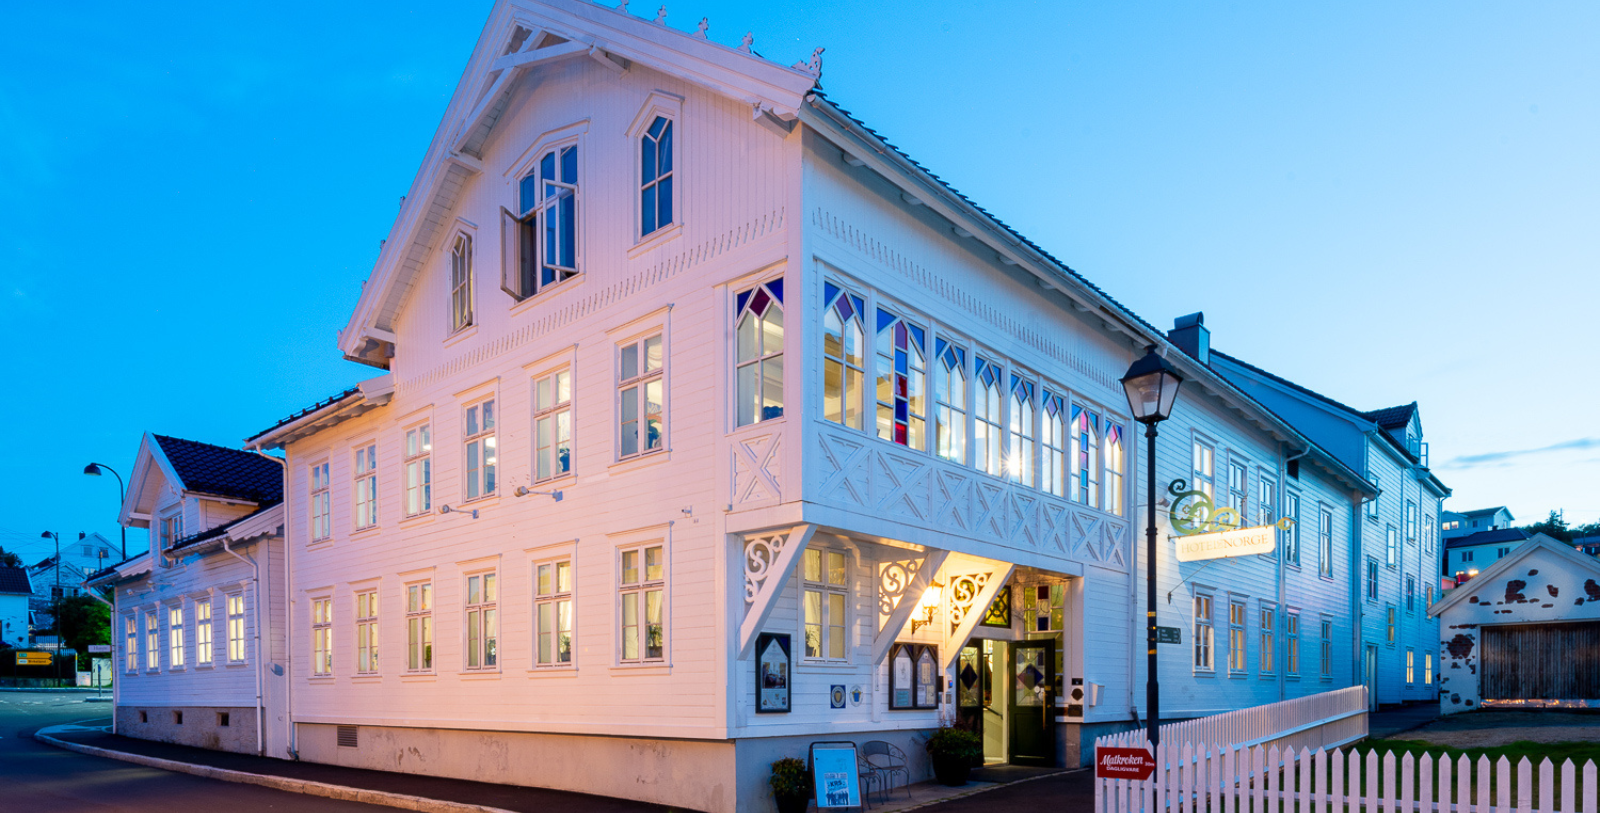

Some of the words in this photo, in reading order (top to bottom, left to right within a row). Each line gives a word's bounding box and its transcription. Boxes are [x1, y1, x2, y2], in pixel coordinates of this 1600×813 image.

[1222, 533, 1268, 548] NORGE
[1100, 754, 1144, 766] Matkroken
[1106, 765, 1139, 773] DAGLIGVARE
